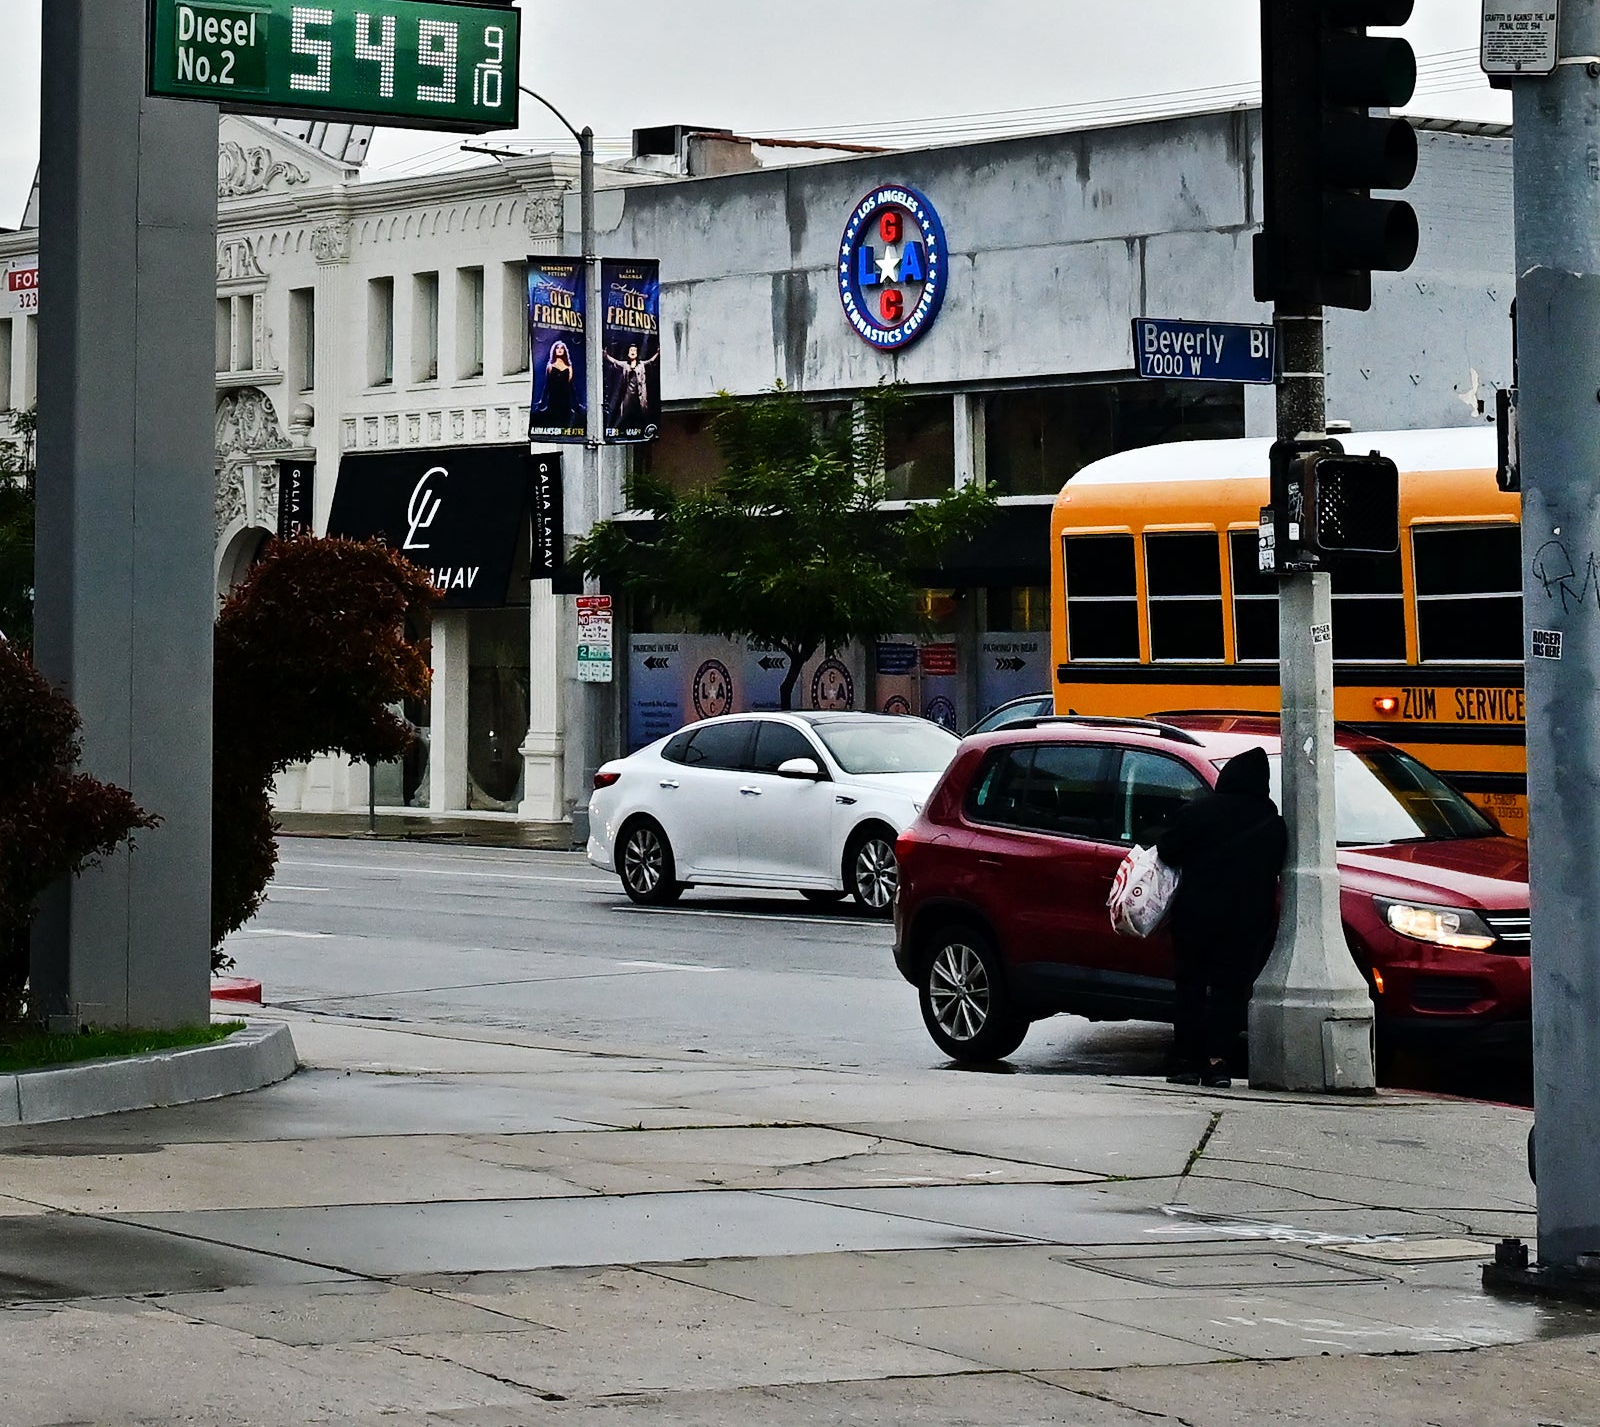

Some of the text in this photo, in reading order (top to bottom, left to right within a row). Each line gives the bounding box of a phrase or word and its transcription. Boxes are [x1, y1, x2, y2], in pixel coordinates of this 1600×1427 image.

[177, 47, 235, 85] No.2
[179, 6, 257, 47] Diesel
[290, 6, 458, 104] 549
[857, 190, 919, 220] LOS ANGELES
[550, 290, 572, 309] OLD
[623, 293, 645, 311] OLD
[843, 282, 936, 344] GYMNASTICS CENTER
[533, 303, 583, 328] FRIENDS
[606, 306, 657, 330] FRIENDS
[1144, 323, 1224, 364] Beverly
[1144, 354, 1202, 376] 7000 W
[291, 468, 301, 514] GALIA
[539, 463, 553, 568] GALIA LAHAV
[578, 616, 589, 625] NO
[1532, 630, 1561, 645] ROGER
[1402, 688, 1437, 720] ZUM
[1455, 687, 1526, 721] SERVICE
